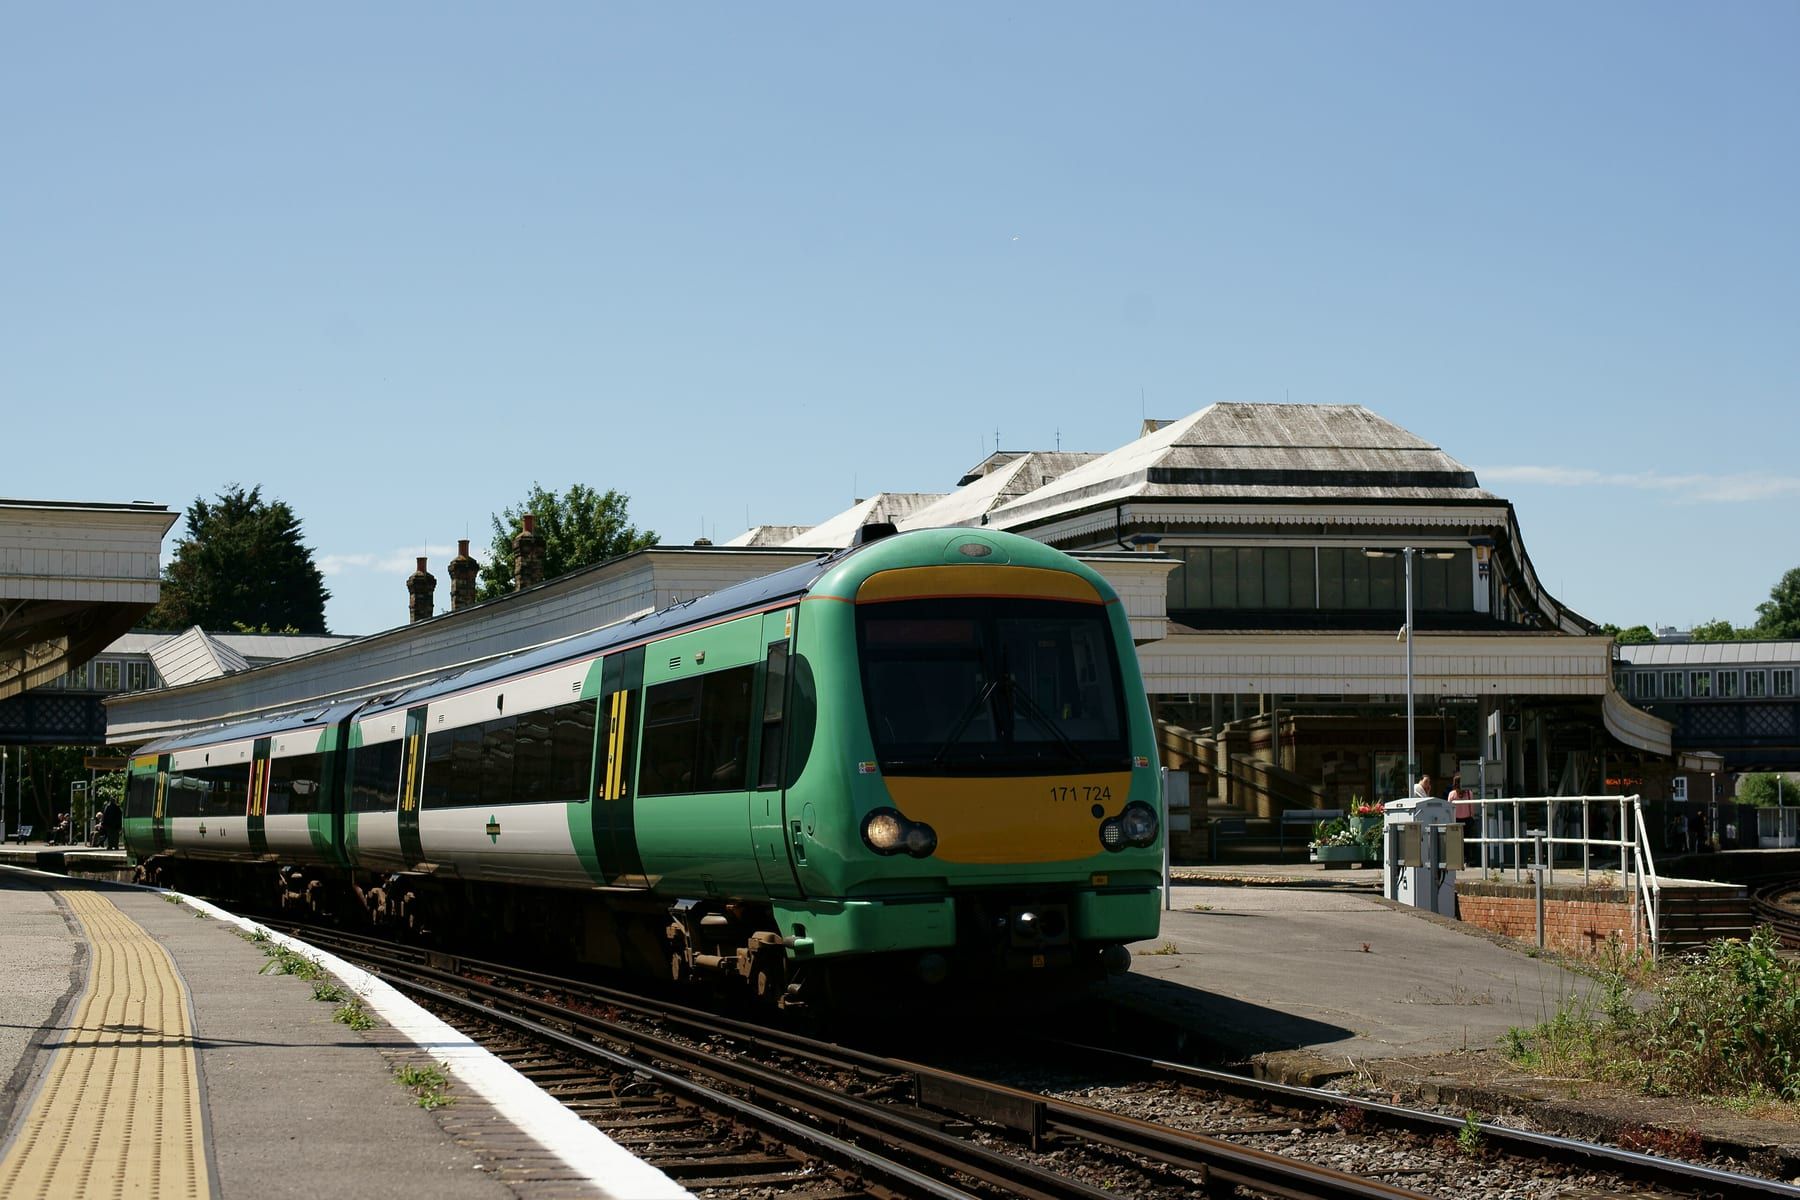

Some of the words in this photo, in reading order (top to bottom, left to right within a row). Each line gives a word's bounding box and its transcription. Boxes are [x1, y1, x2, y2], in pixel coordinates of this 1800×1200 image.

[1507, 715, 1517, 730] 2
[1050, 786, 1077, 801] 171
[1083, 786, 1112, 801] 724
